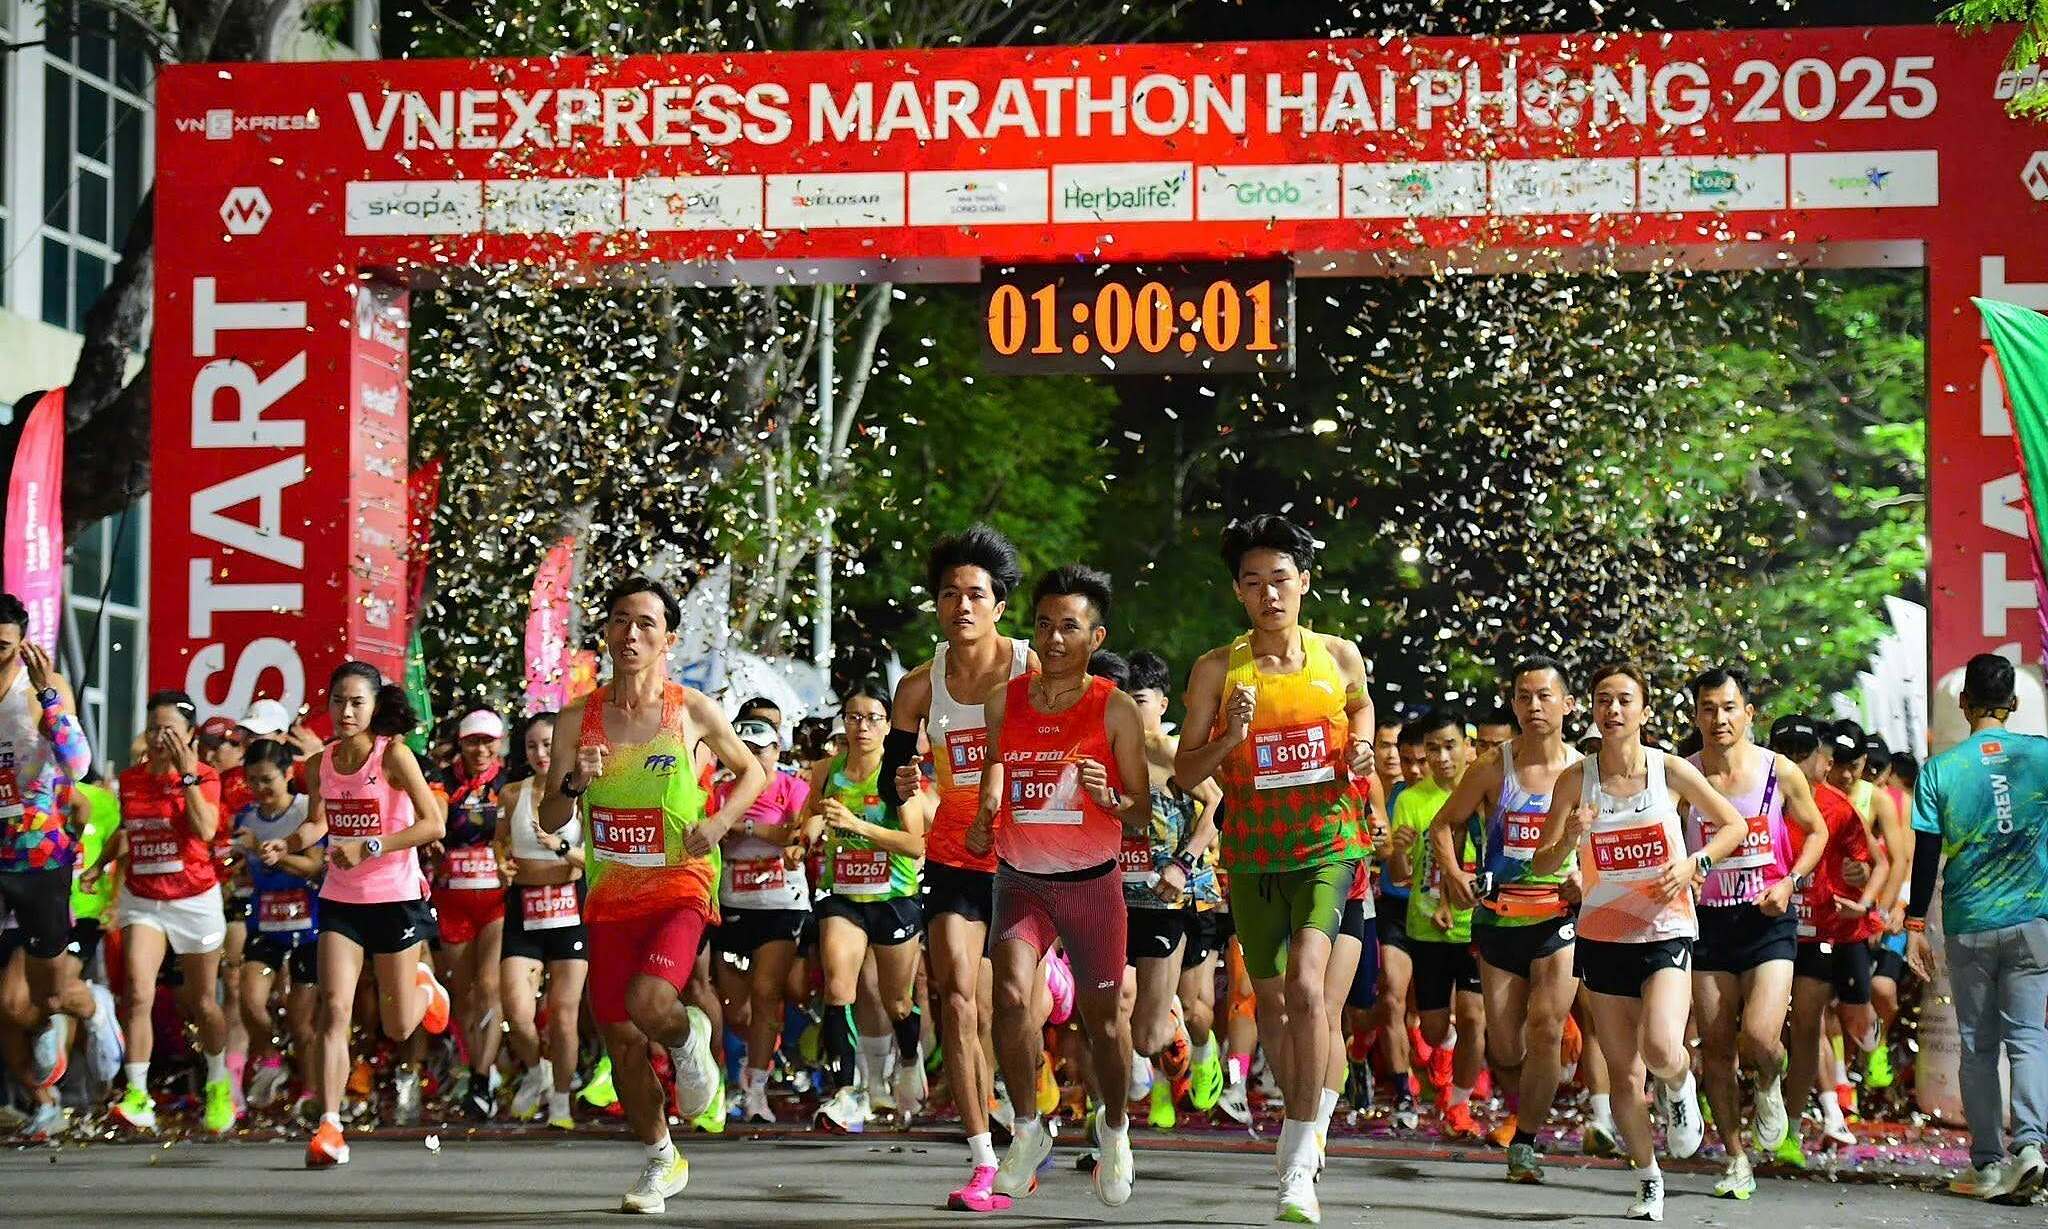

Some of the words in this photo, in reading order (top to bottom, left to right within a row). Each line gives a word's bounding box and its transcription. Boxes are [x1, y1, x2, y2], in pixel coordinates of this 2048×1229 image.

[348, 83, 791, 151] VNEXPRESS
[808, 72, 1247, 144] MARATHON
[1733, 55, 1938, 122] 2025
[1236, 180, 1300, 204] Grab
[987, 279, 1279, 355] 01:00:01
[184, 276, 307, 726] START
[967, 744, 988, 762] 81
[1276, 740, 1327, 763] 81071
[1989, 773, 2014, 835] CREW
[334, 813, 380, 828] 80202
[609, 826, 656, 843] 81137
[1520, 826, 1540, 840] 80
[1117, 849, 1149, 864] 0163
[1613, 840, 1664, 861] 81075
[846, 862, 887, 876] 82267
